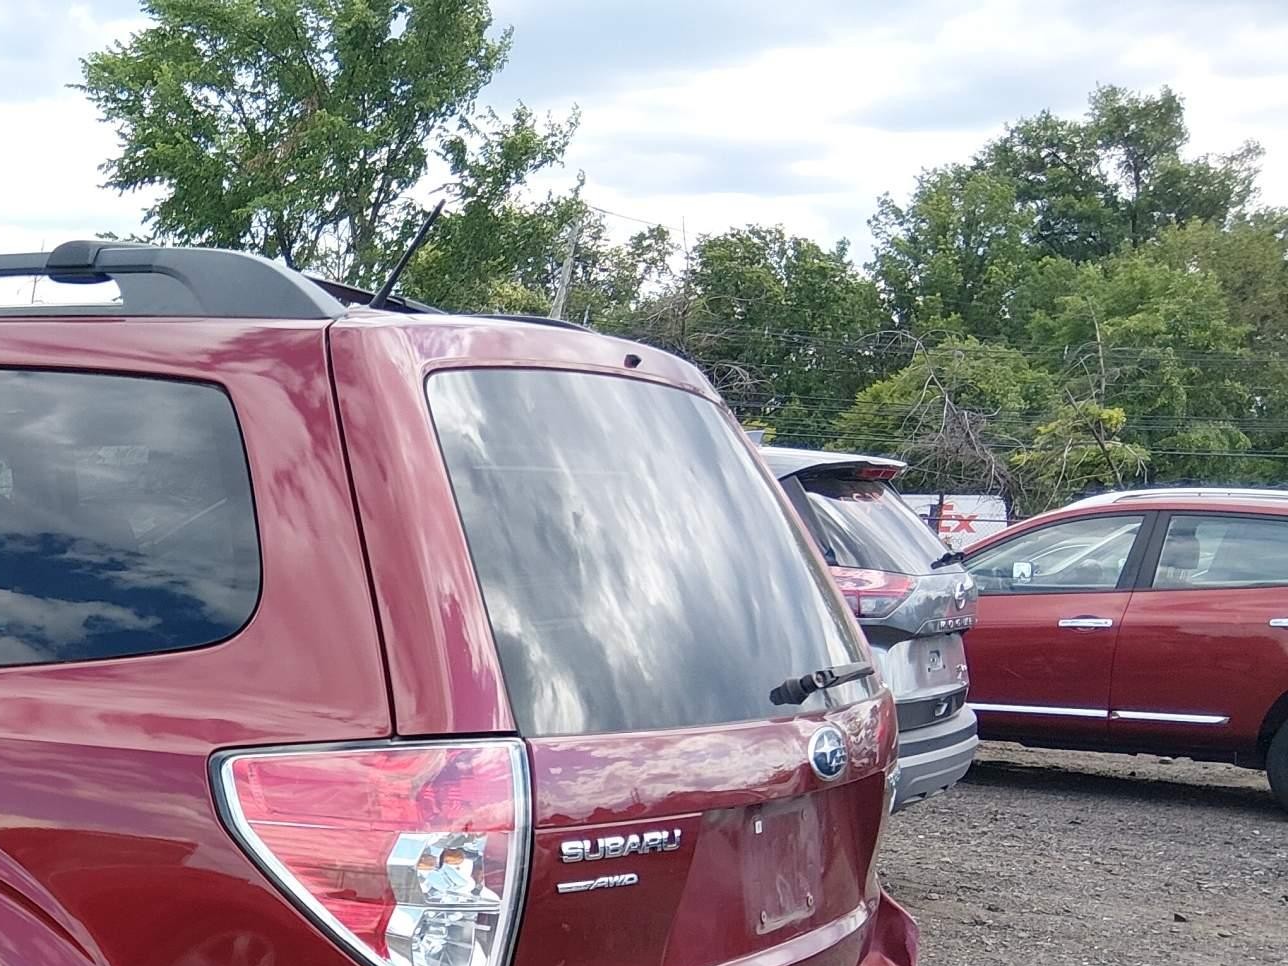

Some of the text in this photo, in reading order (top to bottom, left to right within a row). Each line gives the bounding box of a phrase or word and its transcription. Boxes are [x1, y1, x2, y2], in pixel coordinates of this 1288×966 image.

[919, 503, 979, 534] dEx
[560, 828, 682, 863] SUBARU
[590, 873, 639, 890] AWD
